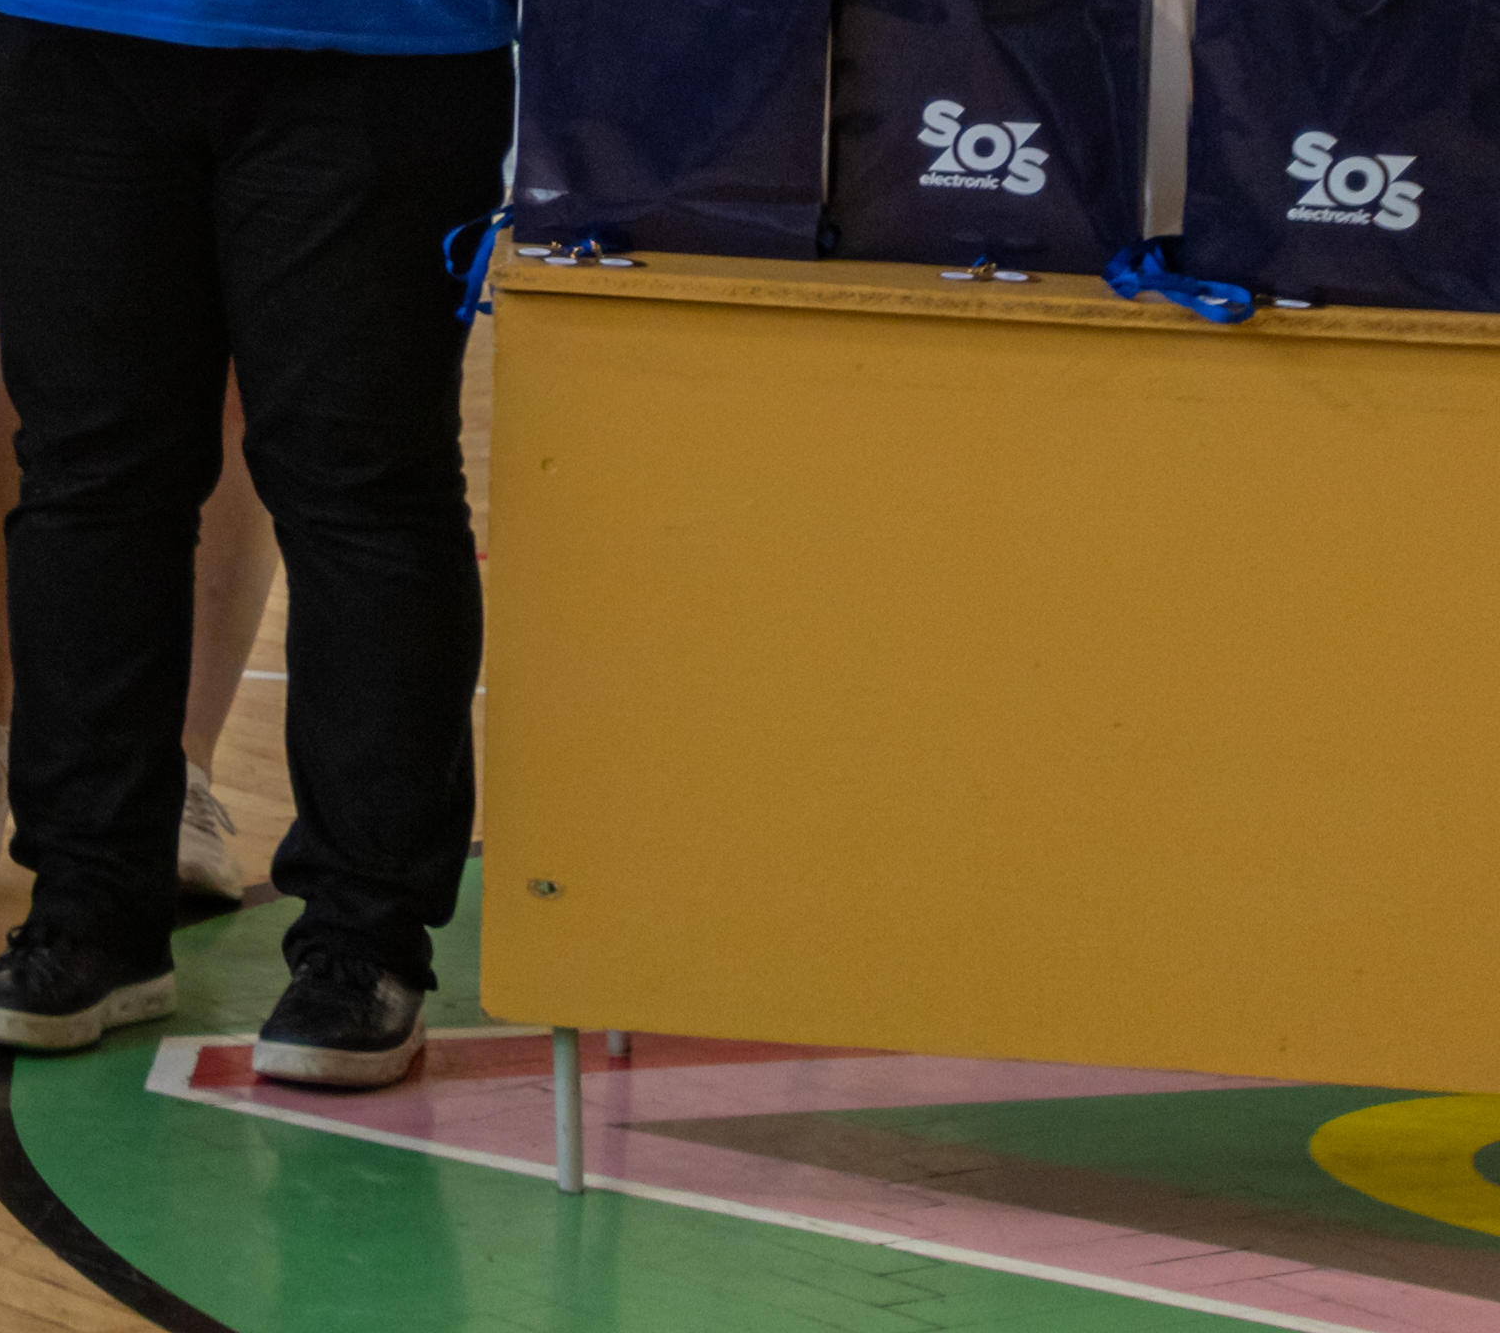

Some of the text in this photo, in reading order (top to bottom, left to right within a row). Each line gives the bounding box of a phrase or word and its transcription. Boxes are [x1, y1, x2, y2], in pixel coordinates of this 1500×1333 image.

[917, 99, 1049, 196] SOS
[919, 171, 1000, 191] electronic
[1286, 131, 1424, 231] SOS
[1286, 205, 1372, 227] electronic
